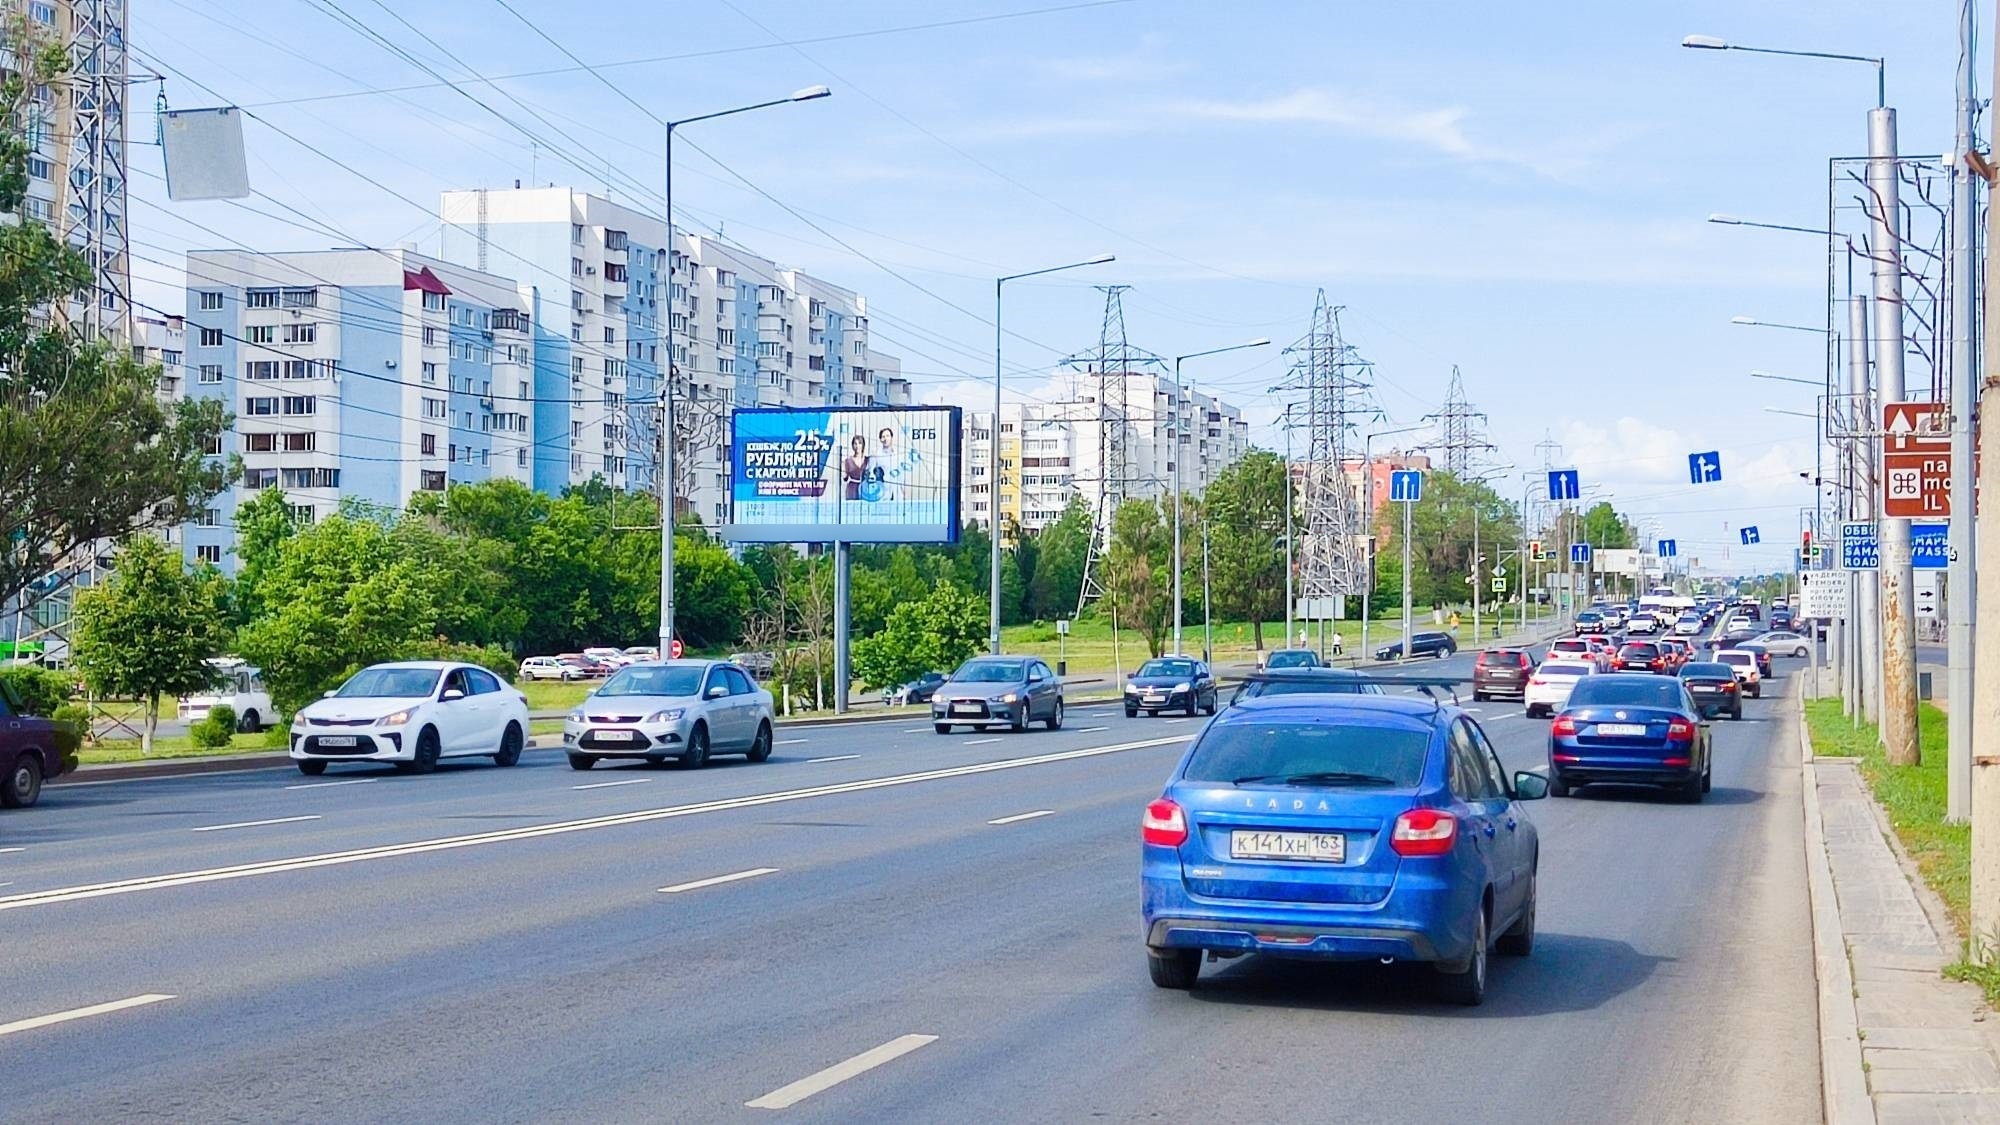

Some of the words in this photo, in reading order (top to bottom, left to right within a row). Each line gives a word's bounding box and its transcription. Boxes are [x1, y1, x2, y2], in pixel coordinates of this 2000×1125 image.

[912, 429, 936, 439] ВТБ
[746, 451, 818, 467] РУБЛЯМИ
[746, 468, 754, 478] С
[755, 466, 796, 478] КАРТОЙ
[1844, 558, 1877, 567] ROAD
[1246, 798, 1328, 811] LADA
[1238, 834, 1307, 853] К141ХН
[1312, 835, 1340, 849] 163
